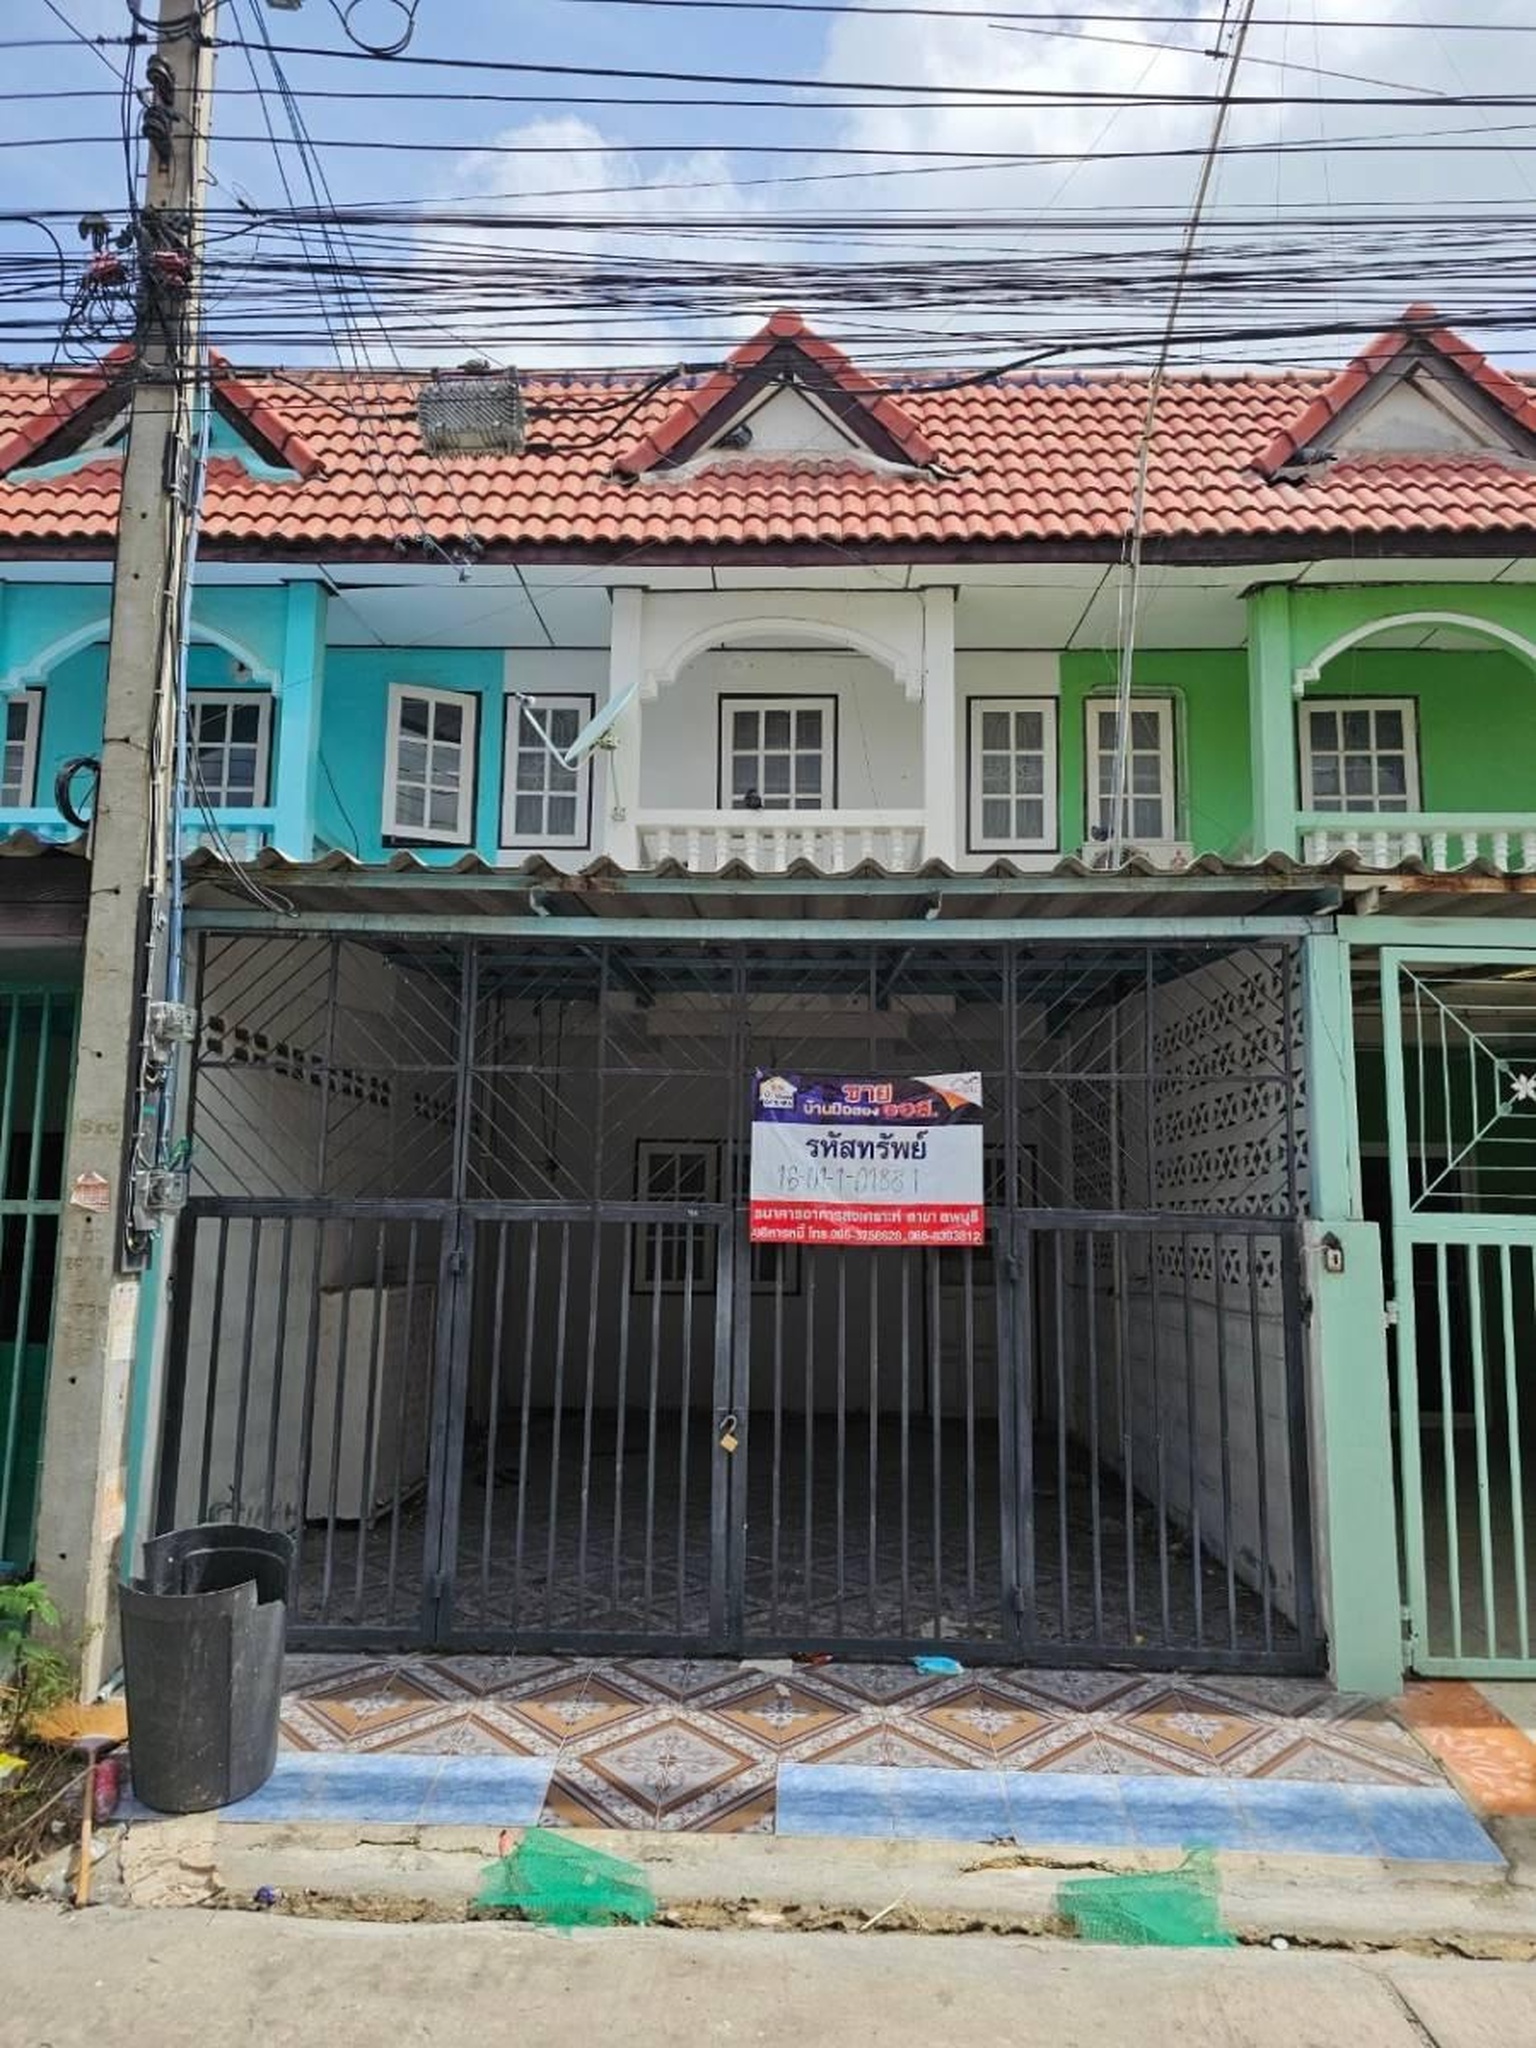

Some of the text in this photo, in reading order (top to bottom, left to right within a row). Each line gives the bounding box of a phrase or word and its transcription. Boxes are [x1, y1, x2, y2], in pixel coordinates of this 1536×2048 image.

[841, 1083, 893, 1104] ขาย
[805, 1129, 929, 1160] รหัสทรัพย์
